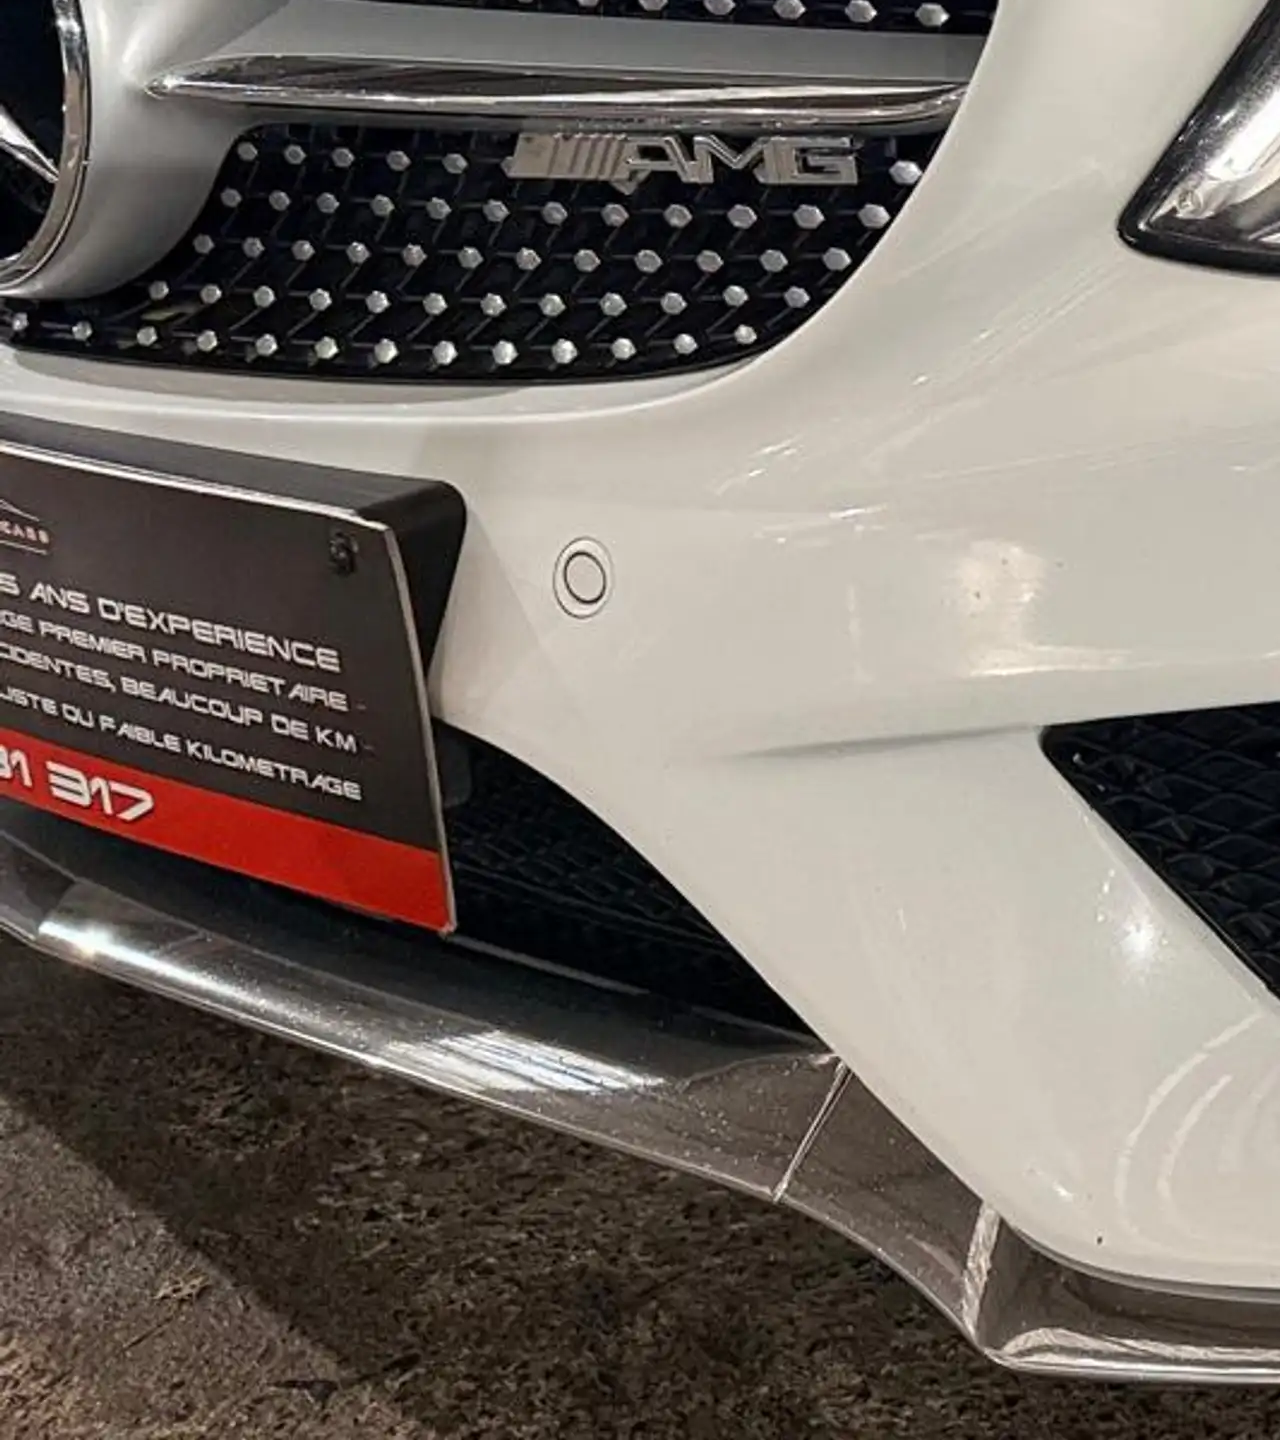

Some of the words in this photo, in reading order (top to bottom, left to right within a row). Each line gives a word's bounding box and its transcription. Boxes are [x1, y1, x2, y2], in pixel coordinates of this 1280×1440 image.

[606, 135, 859, 195] AMG
[0, 609, 35, 635] GE
[38, 620, 147, 664] PREMIER
[29, 581, 91, 615] ANS
[97, 596, 342, 674] D'EXPERIENCE
[120, 675, 263, 727] BEAUCOUP
[271, 713, 310, 742] DE
[315, 725, 358, 754] KM
[61, 702, 95, 729] OU
[186, 739, 362, 802] KILOMETRAGE
[45, 760, 154, 822] 317
